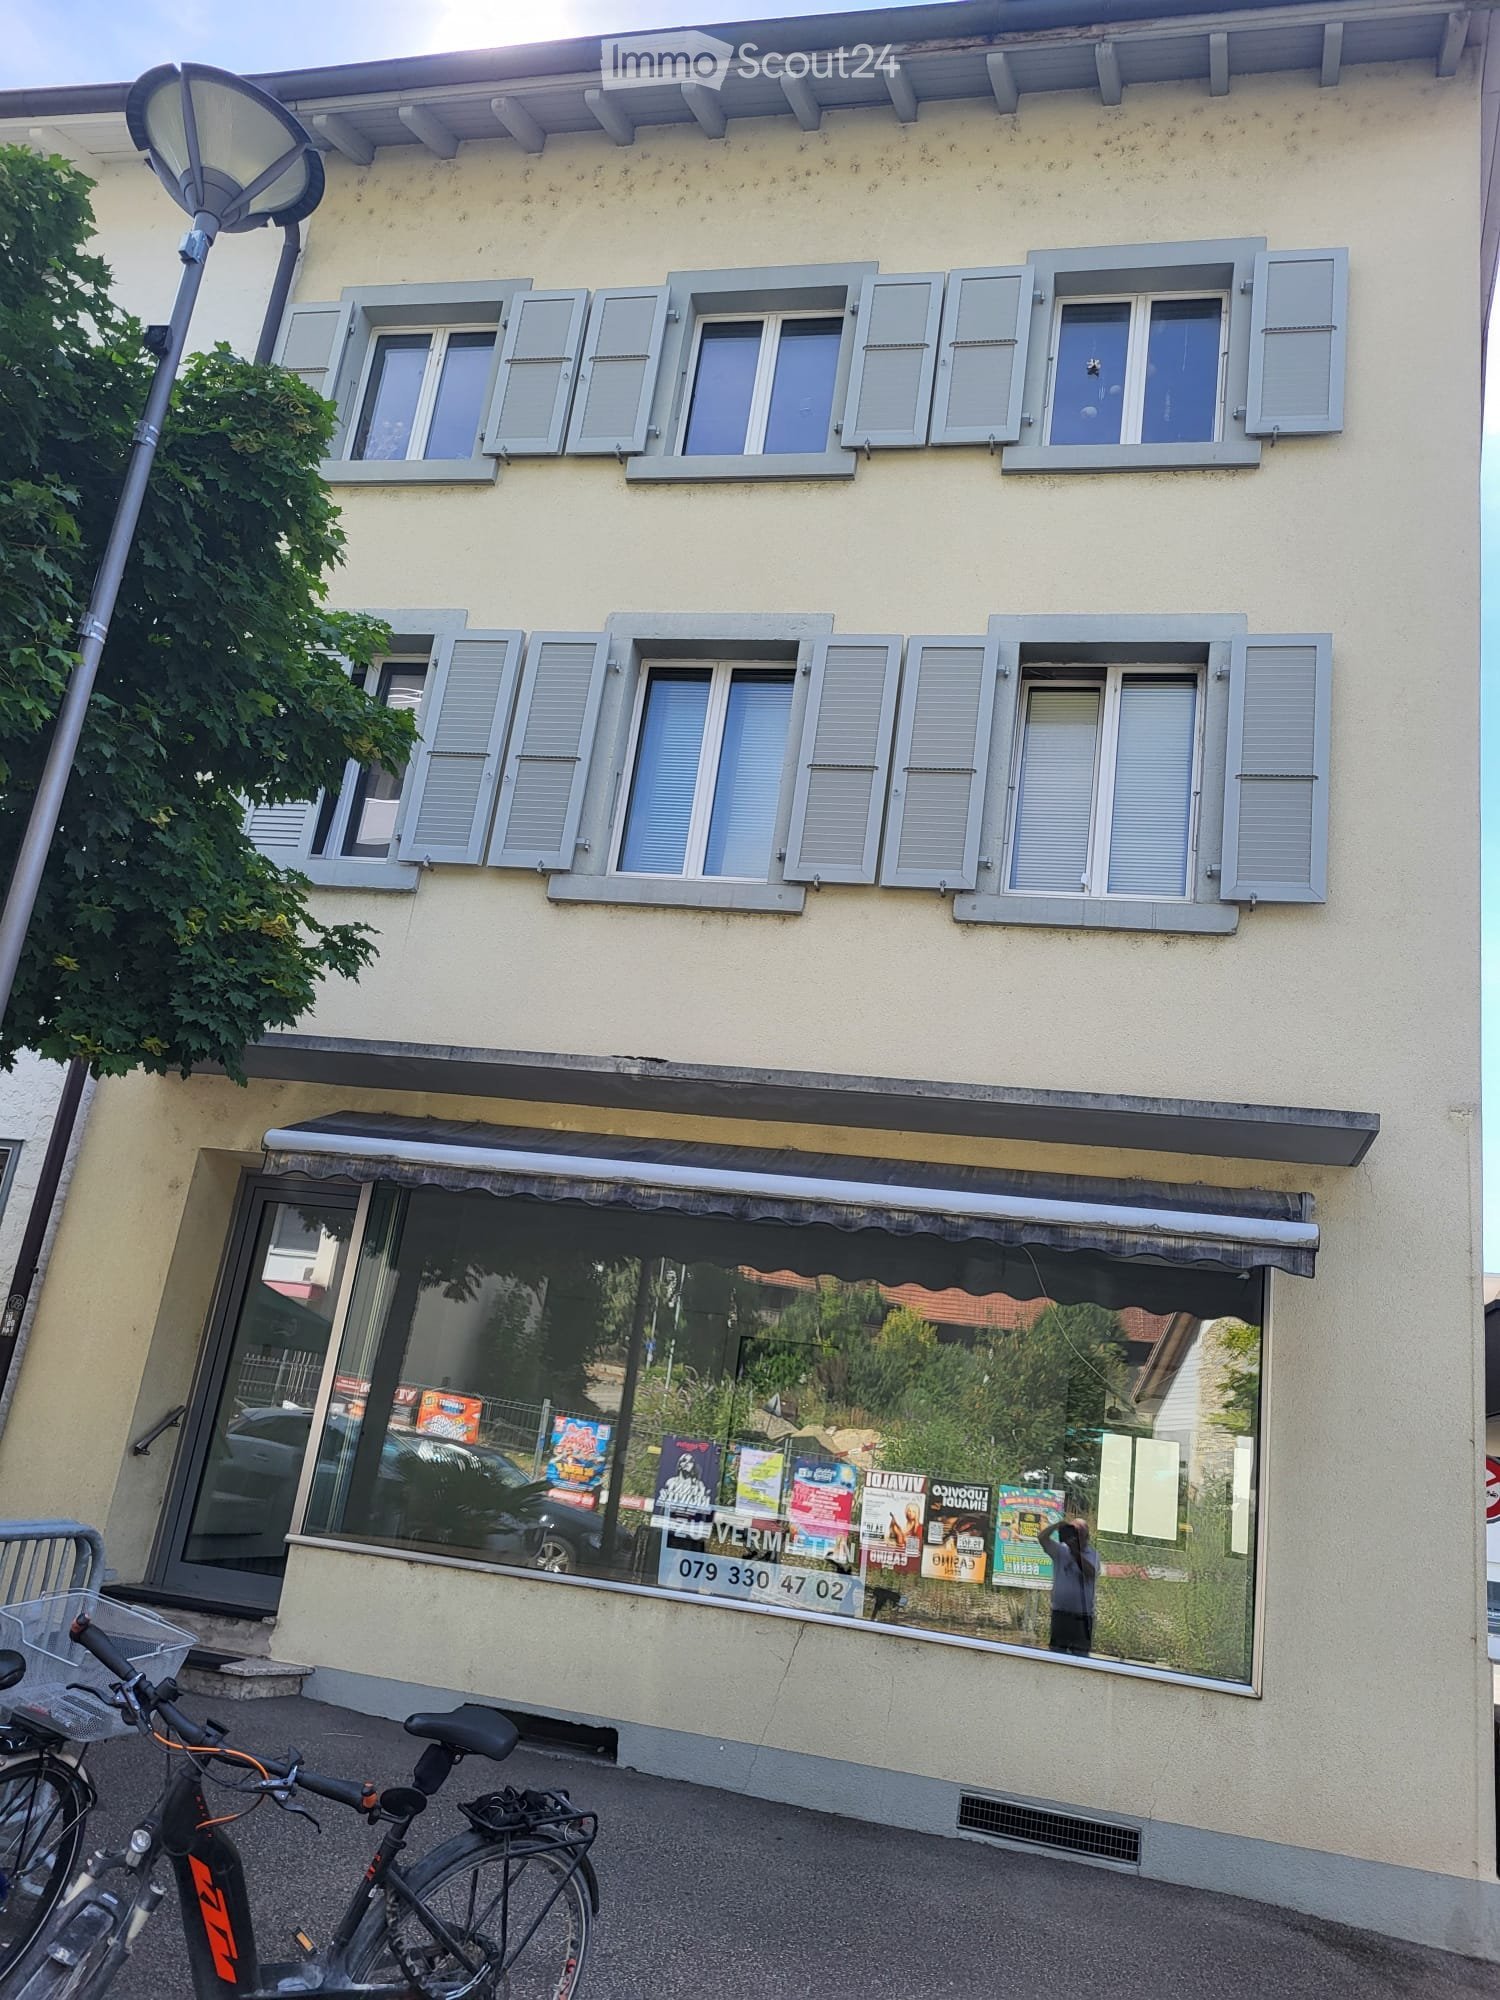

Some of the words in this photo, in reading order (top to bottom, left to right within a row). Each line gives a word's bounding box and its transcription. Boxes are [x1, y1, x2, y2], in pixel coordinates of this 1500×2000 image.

[679, 1558, 718, 1581] 079
[728, 1566, 770, 1589] 330
[780, 1575, 807, 1595] 47
[816, 1579, 844, 1601] 02
[188, 1854, 239, 1985] KTM
